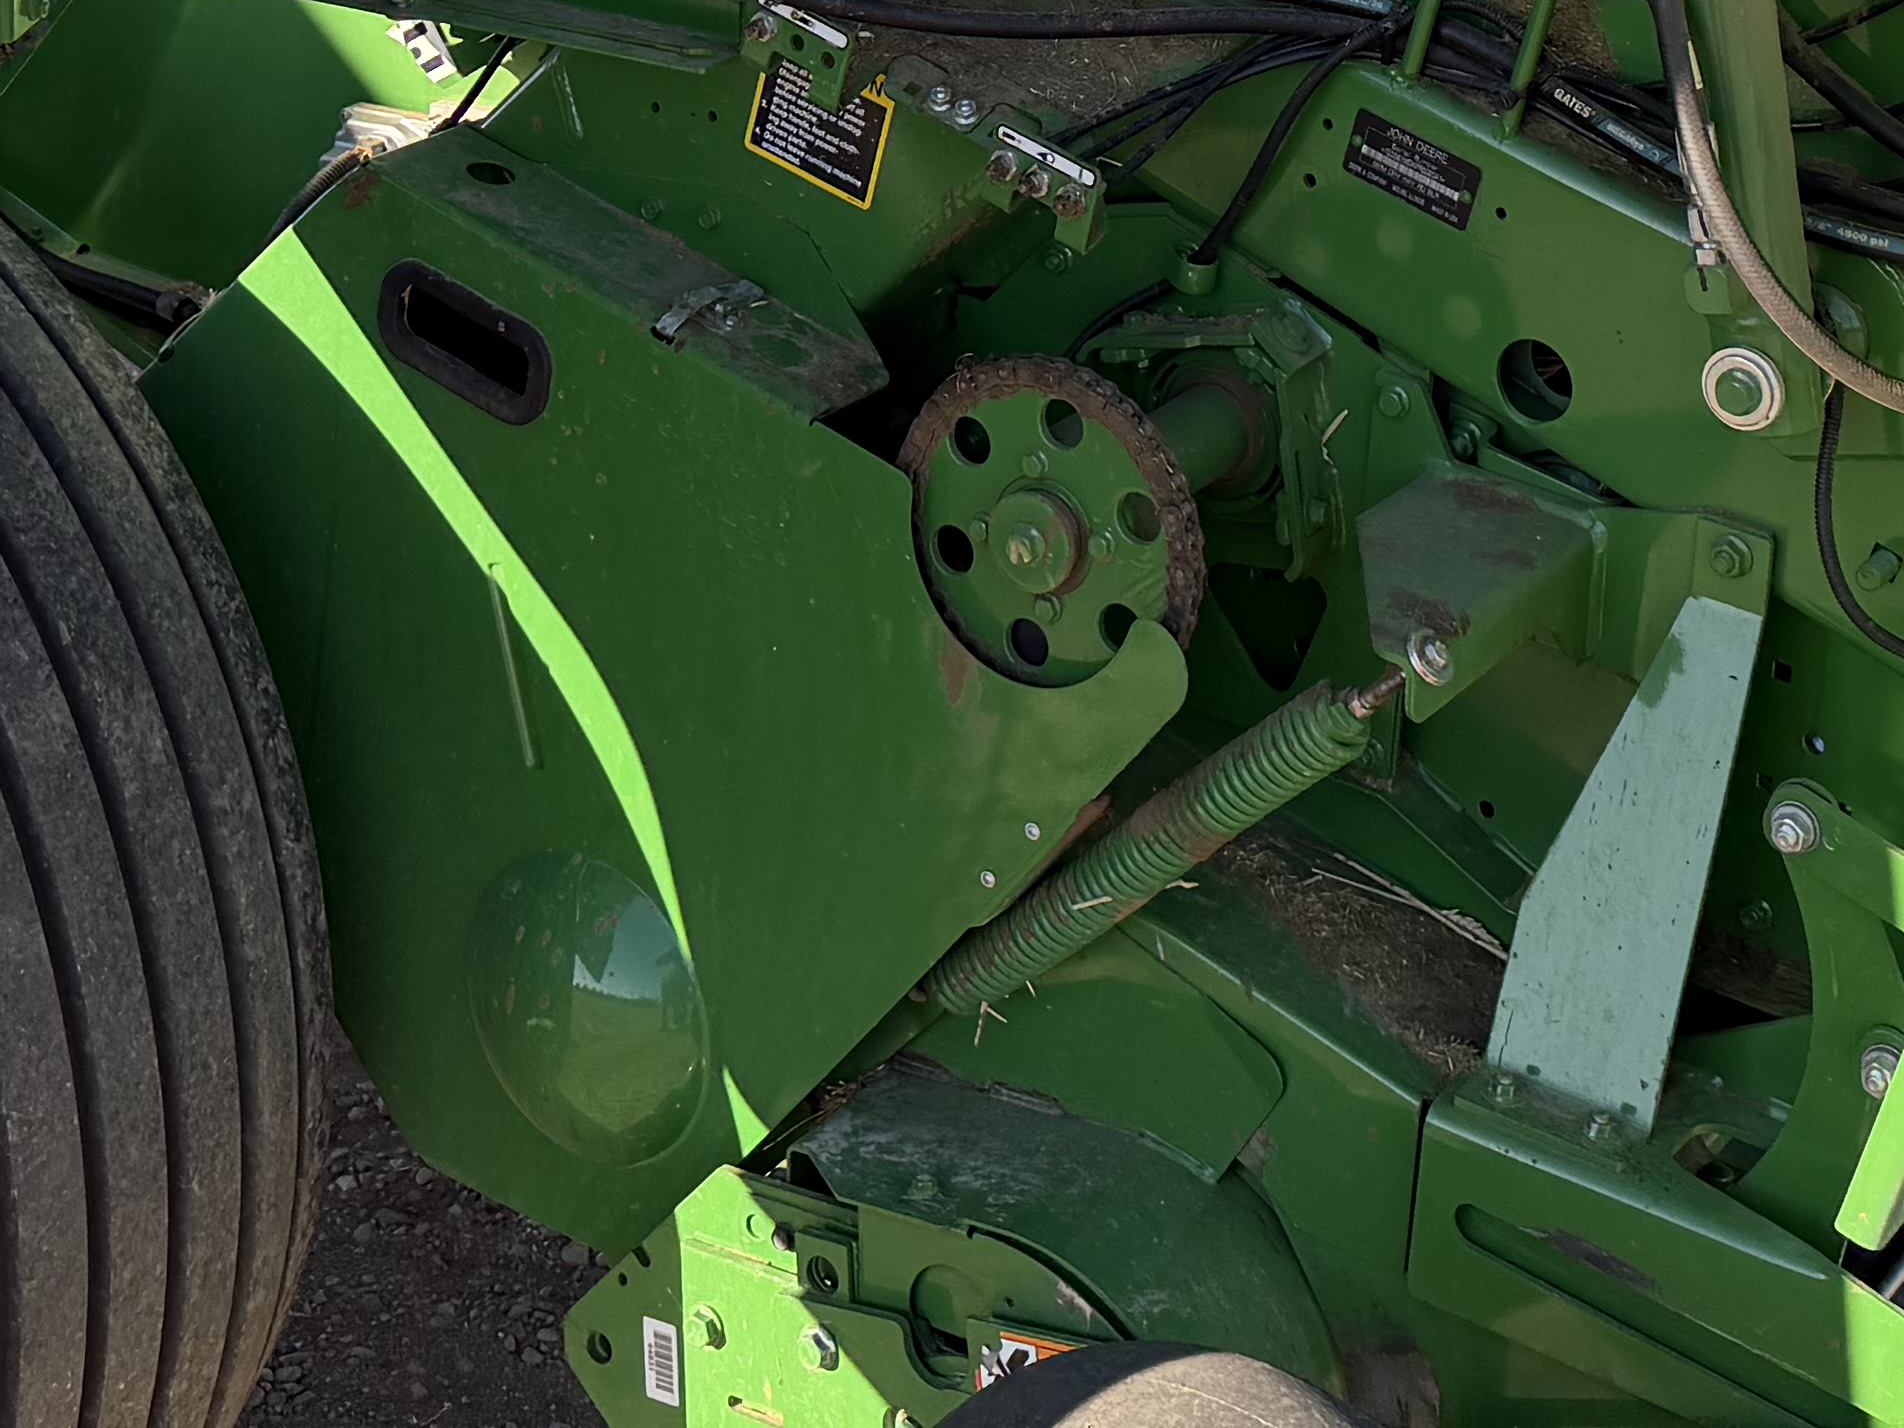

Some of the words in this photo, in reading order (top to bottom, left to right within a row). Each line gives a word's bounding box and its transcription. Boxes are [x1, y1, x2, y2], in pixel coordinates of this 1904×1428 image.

[1553, 88, 1592, 119] GATES
[1386, 127, 1414, 147] JOHN
[1416, 141, 1450, 165] DEERE
